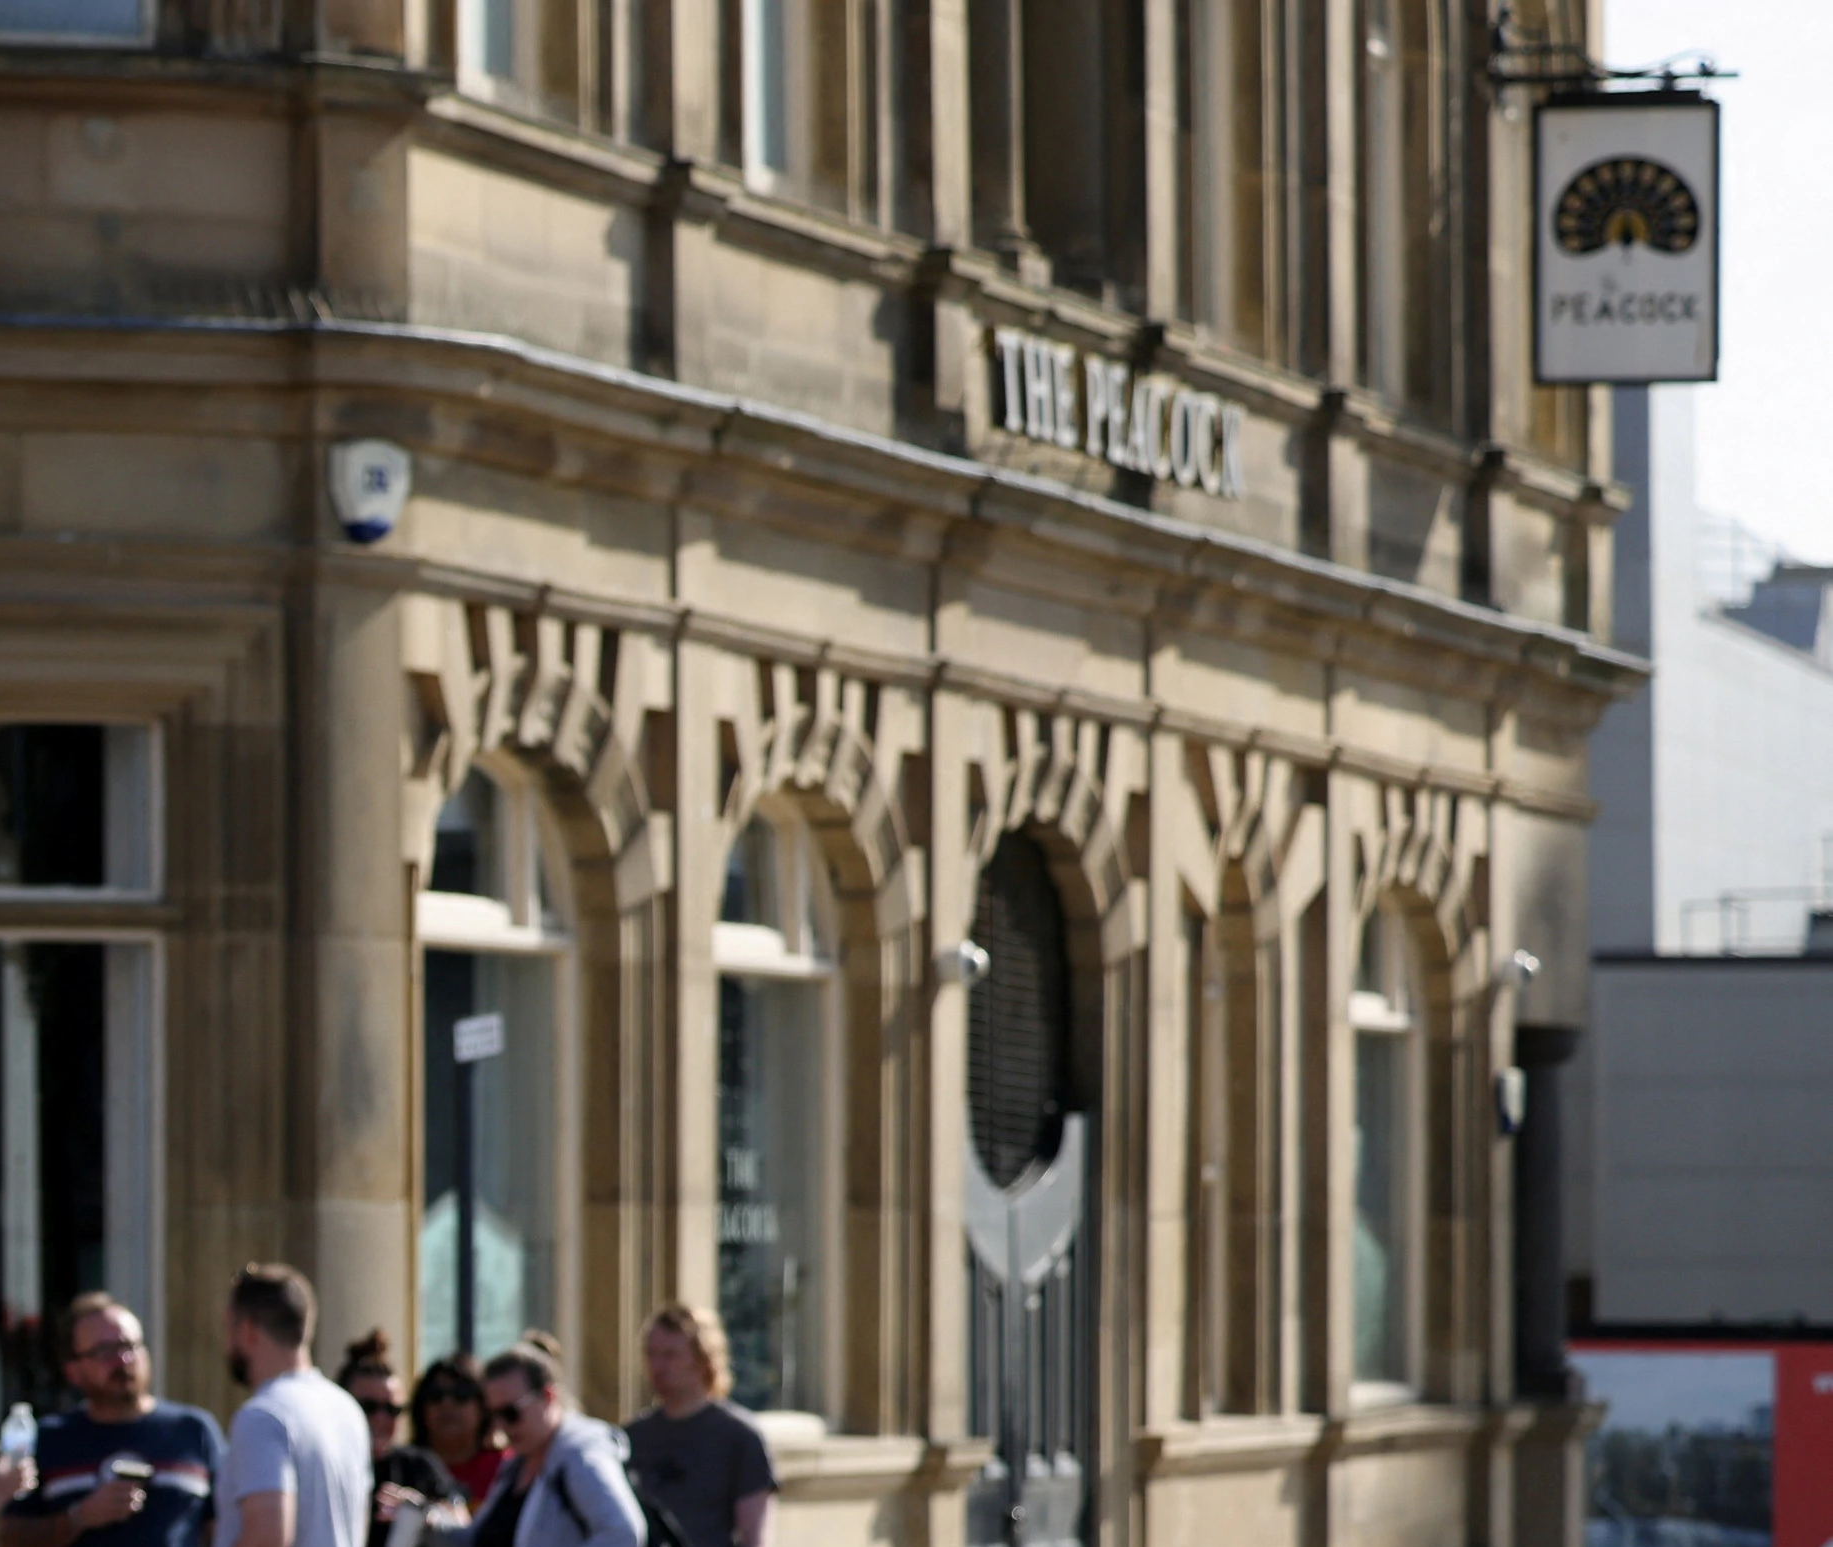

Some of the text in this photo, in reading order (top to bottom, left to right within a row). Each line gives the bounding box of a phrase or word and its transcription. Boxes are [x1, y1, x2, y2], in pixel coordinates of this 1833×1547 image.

[1550, 291, 1699, 325] PEACOCK
[994, 328, 1247, 500] THE PEACOCK
